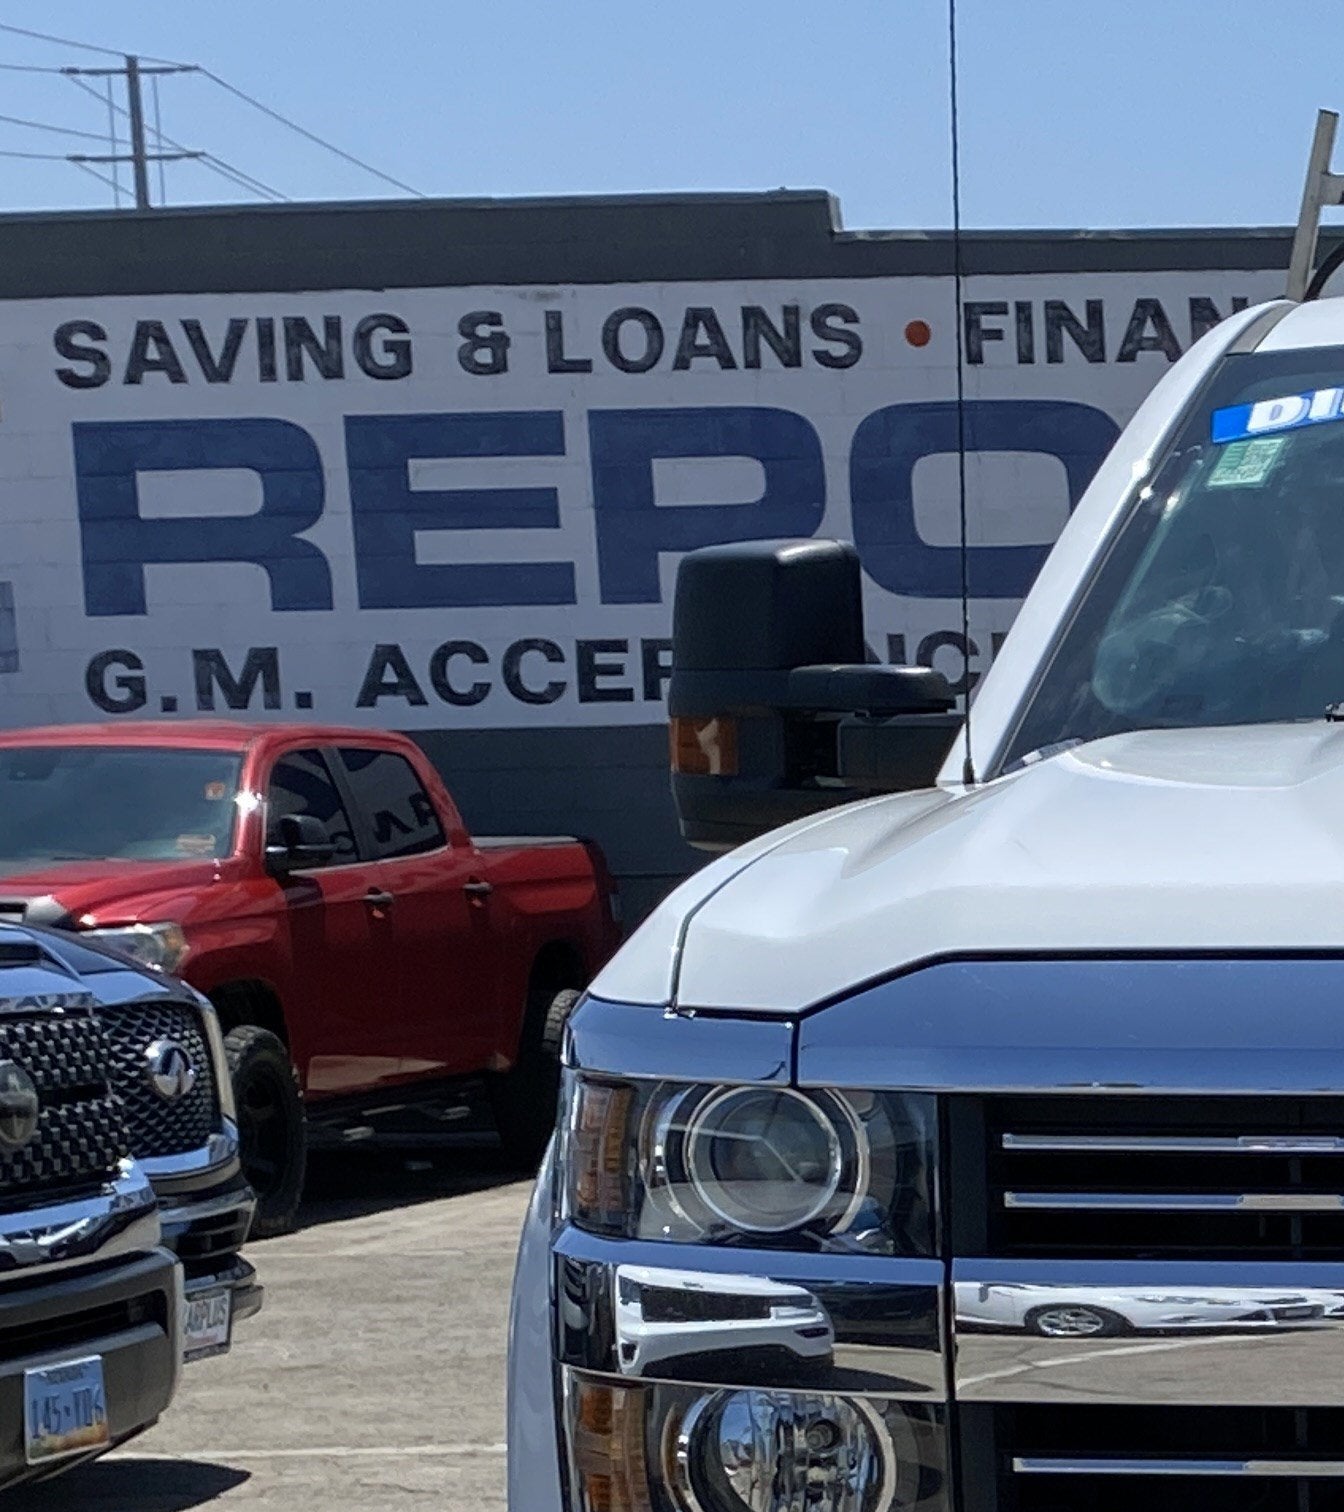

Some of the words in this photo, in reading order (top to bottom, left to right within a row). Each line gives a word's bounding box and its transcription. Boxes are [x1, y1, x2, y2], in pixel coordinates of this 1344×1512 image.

[53, 313, 413, 389] SAVING
[456, 311, 511, 375] &
[544, 303, 863, 374] LOANS
[72, 400, 1122, 617] REPO
[84, 646, 314, 714] G.M.
